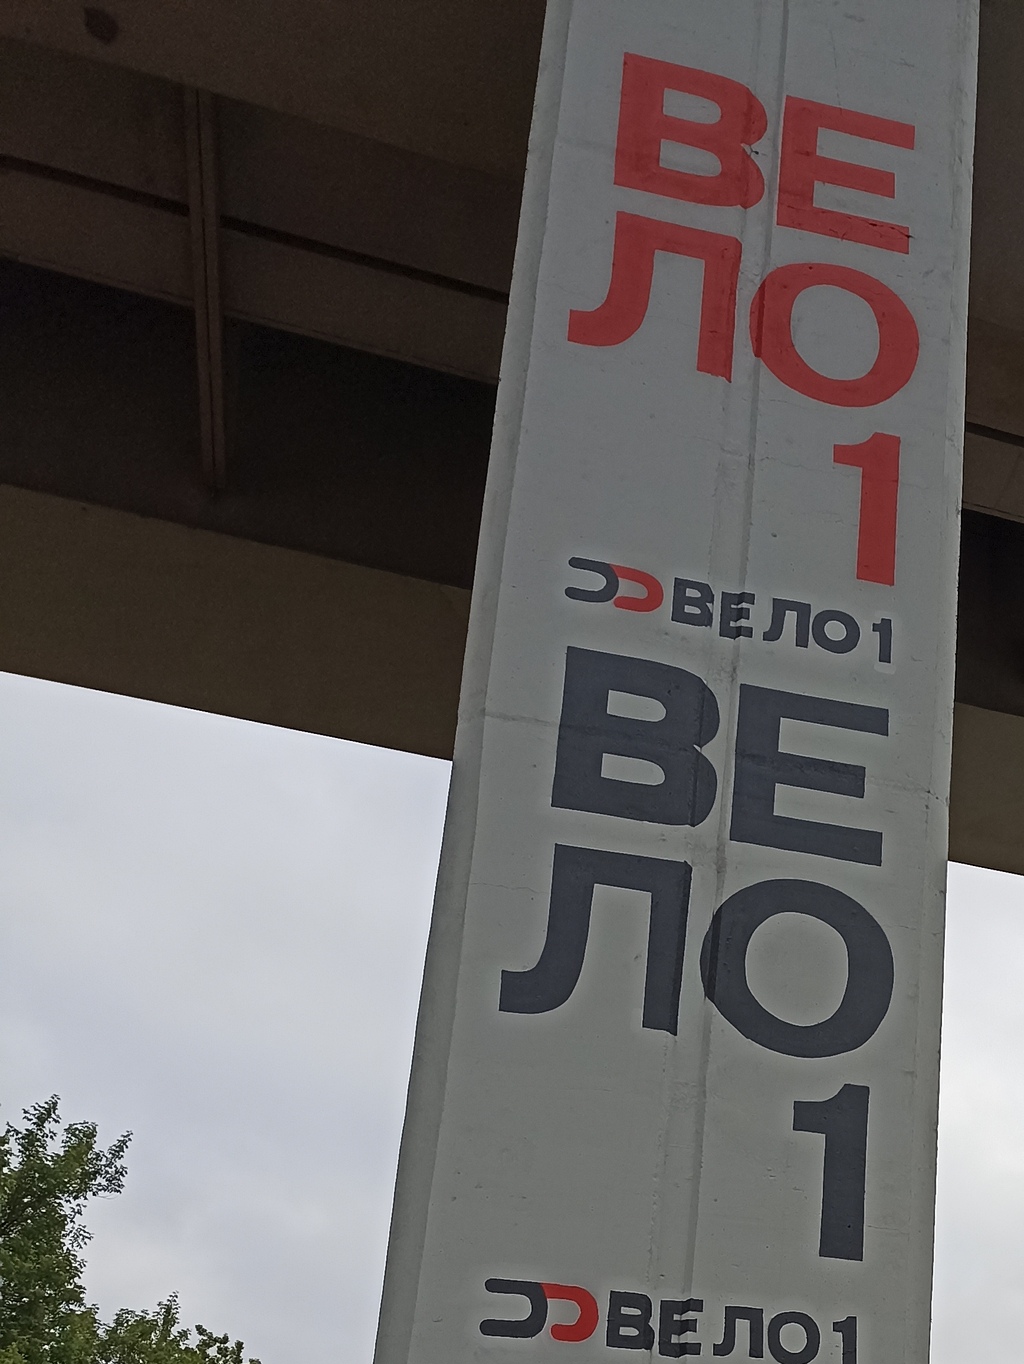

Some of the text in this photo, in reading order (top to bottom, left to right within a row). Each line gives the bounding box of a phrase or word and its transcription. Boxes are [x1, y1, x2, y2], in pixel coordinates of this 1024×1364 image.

[613, 52, 916, 255] ВЕ
[566, 210, 920, 409] ЛО
[832, 431, 901, 586] 1
[550, 645, 890, 867] ВЕ
[498, 842, 895, 1059] ЛО
[792, 1082, 871, 1262] 1
